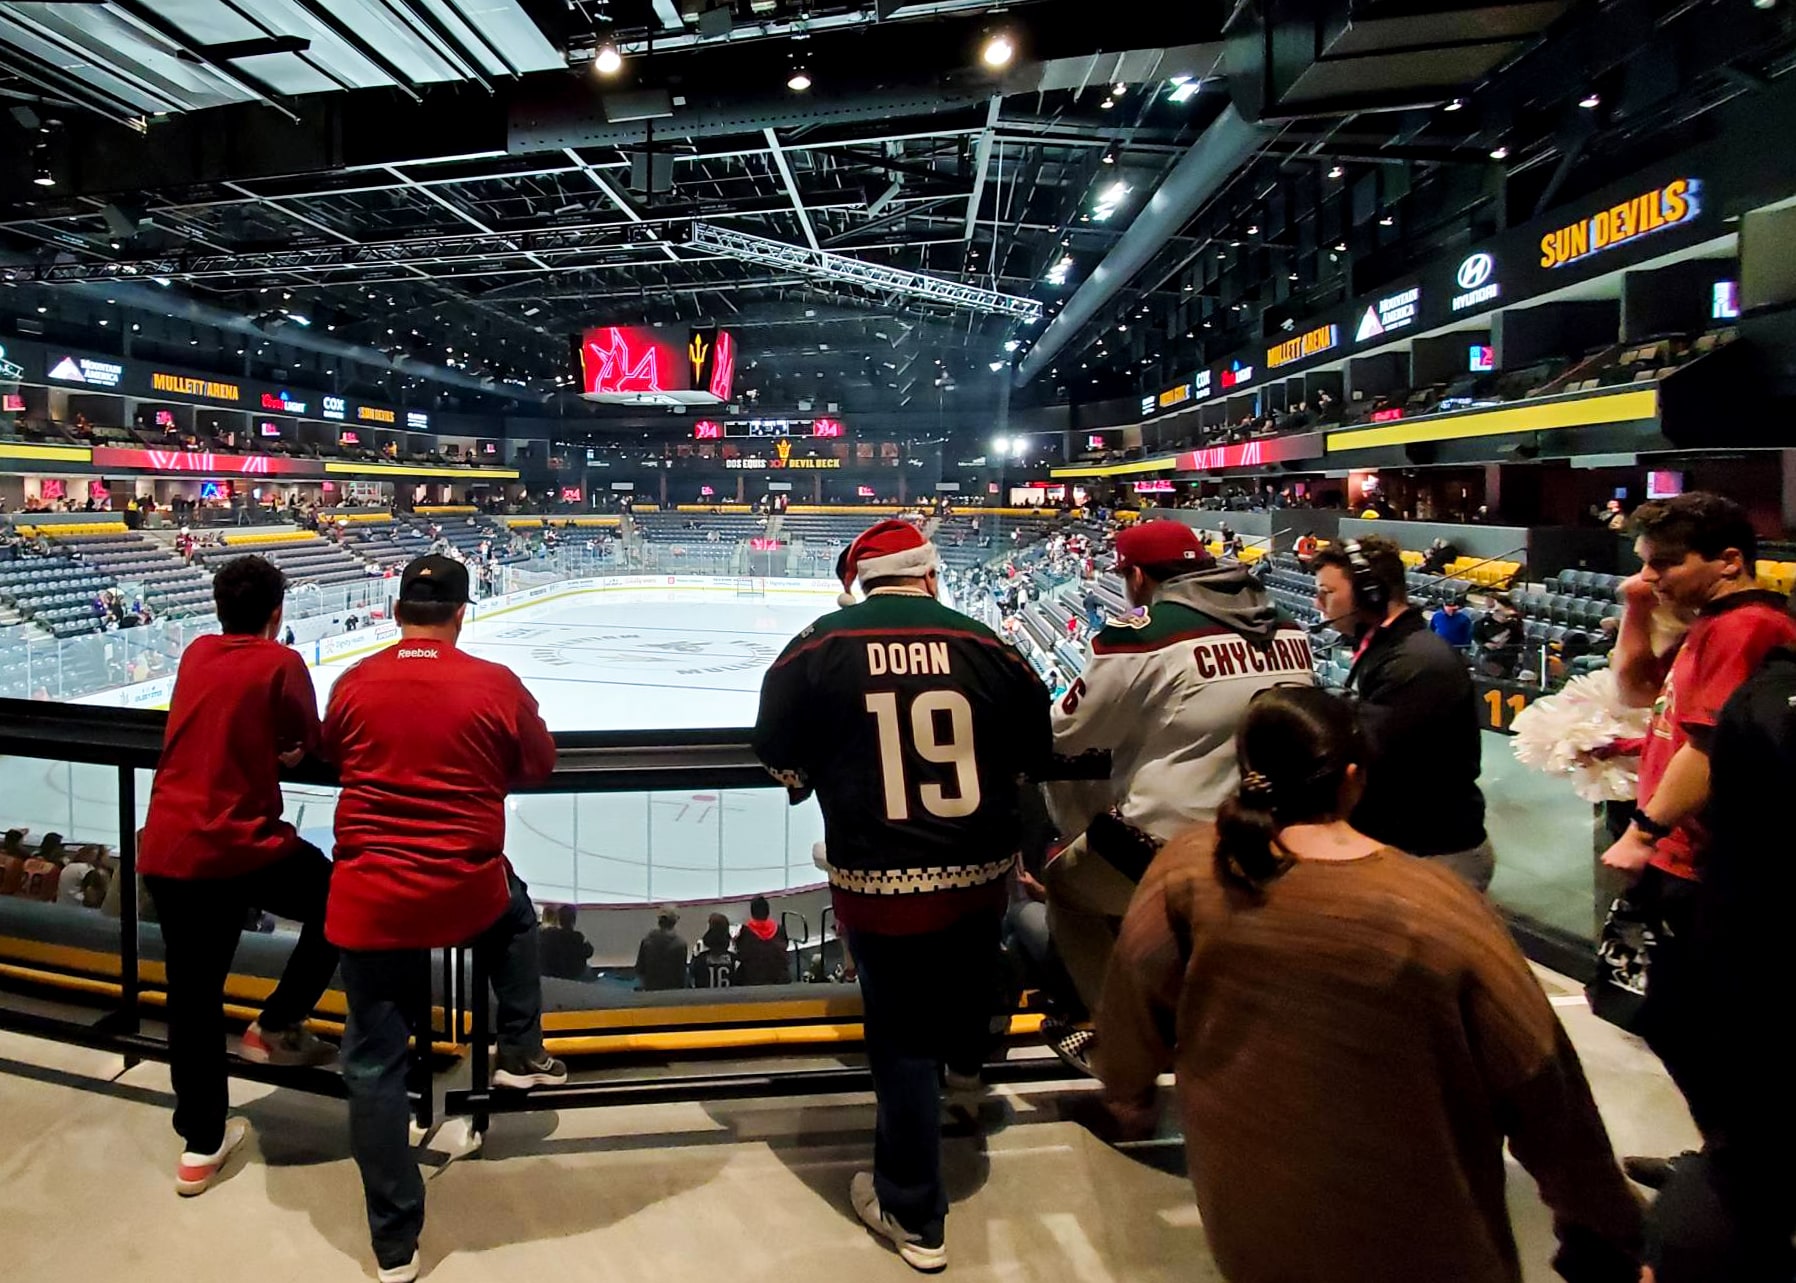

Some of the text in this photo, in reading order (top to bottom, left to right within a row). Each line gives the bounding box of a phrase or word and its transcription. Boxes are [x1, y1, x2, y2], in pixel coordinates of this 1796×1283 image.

[1540, 180, 1687, 268] SUN DEVILS
[1453, 283, 1498, 311] HYUNDAI
[1267, 324, 1331, 368] MULLETT ARENA
[153, 373, 239, 400] MULLETT ARENA
[323, 397, 345, 411] COX
[726, 459, 742, 469] DOS
[743, 459, 767, 469] EQUIS
[789, 459, 814, 469] DEVIL
[397, 648, 438, 659] Reebok
[867, 641, 951, 675] DOAN
[1062, 677, 1087, 715] 6
[865, 690, 981, 820] 19
[708, 966, 730, 988] 16
